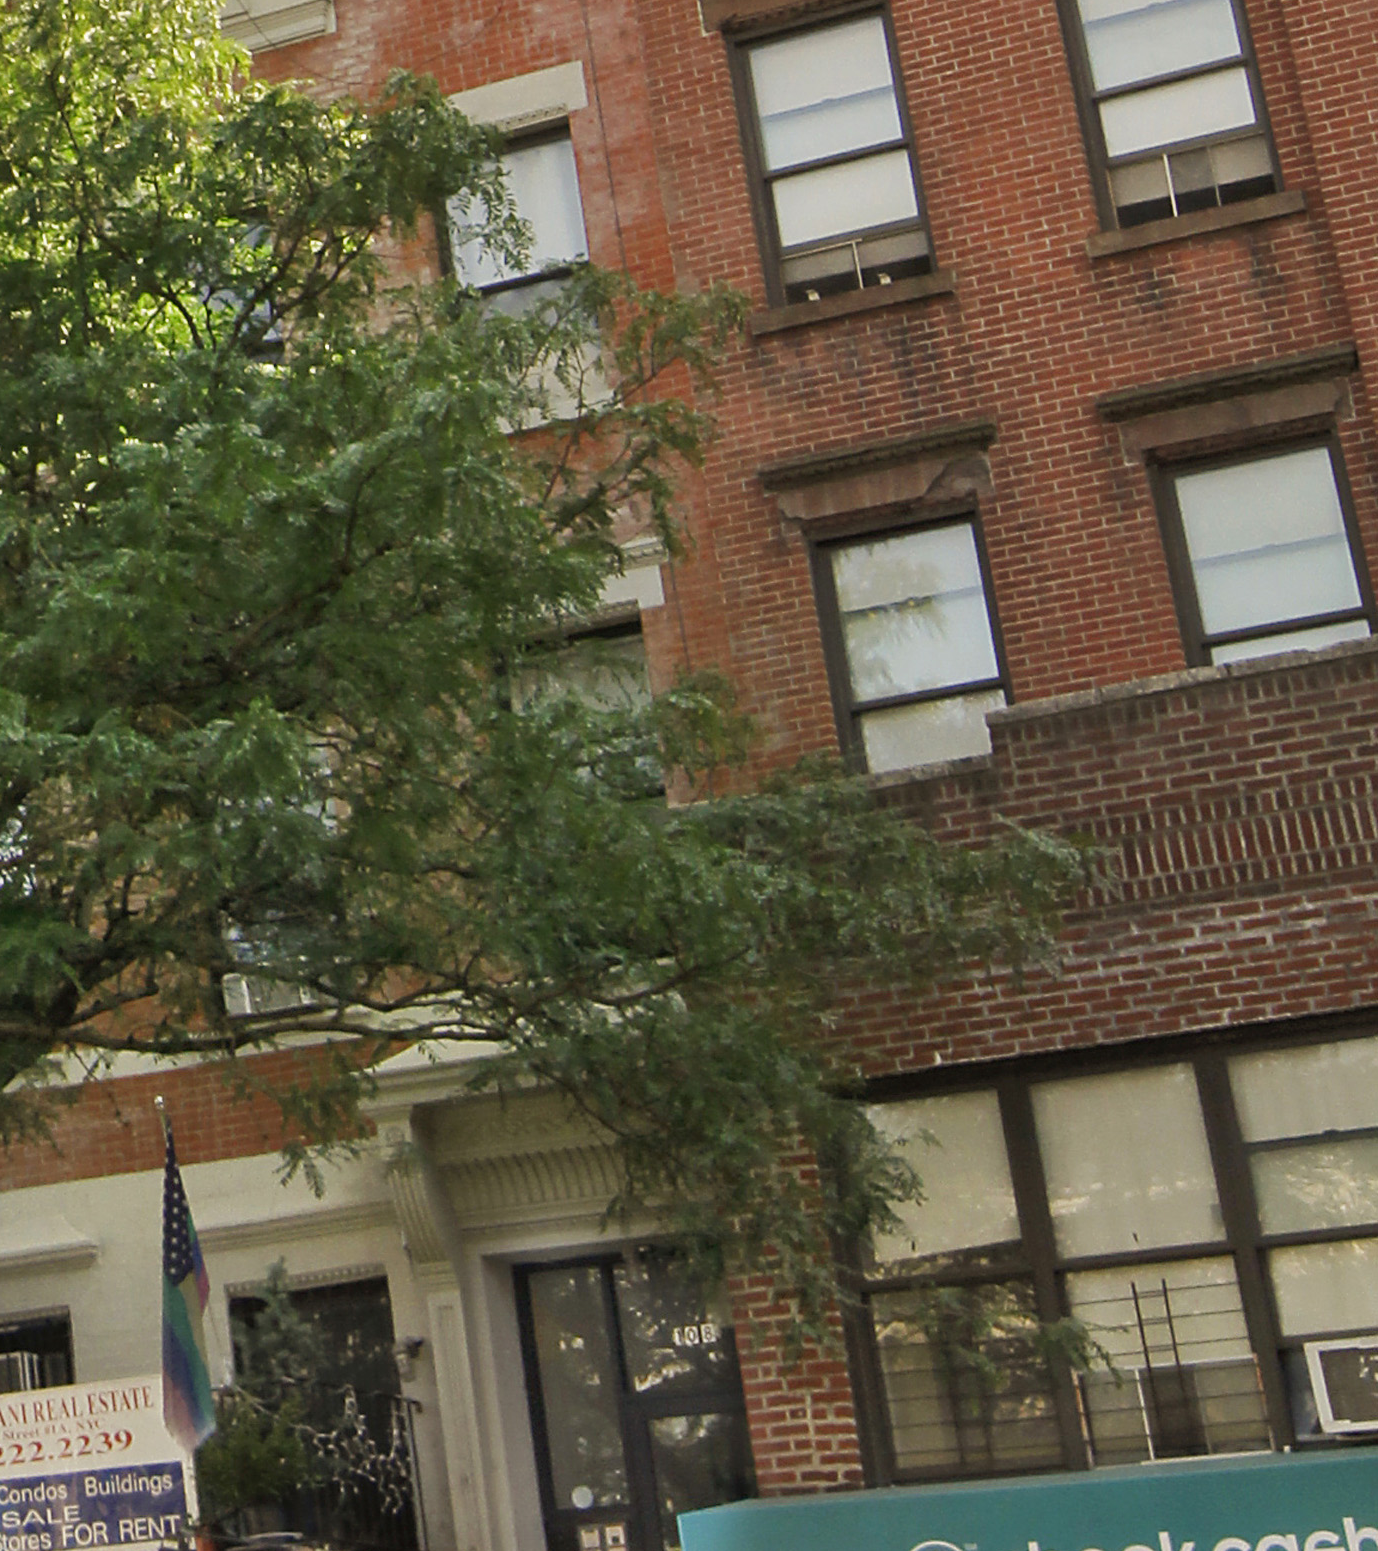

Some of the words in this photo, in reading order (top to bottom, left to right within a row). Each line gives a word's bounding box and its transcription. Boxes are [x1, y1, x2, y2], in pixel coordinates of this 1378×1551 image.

[33, 1397, 85, 1423] REAL
[89, 1386, 154, 1415] ESTATE
[3, 1428, 39, 1440] Street
[77, 1419, 101, 1430] NYC
[85, 1472, 174, 1498] Buildings
[2, 1505, 81, 1528] SALE
[62, 1523, 108, 1548] FOR
[119, 1515, 180, 1542] RENT
